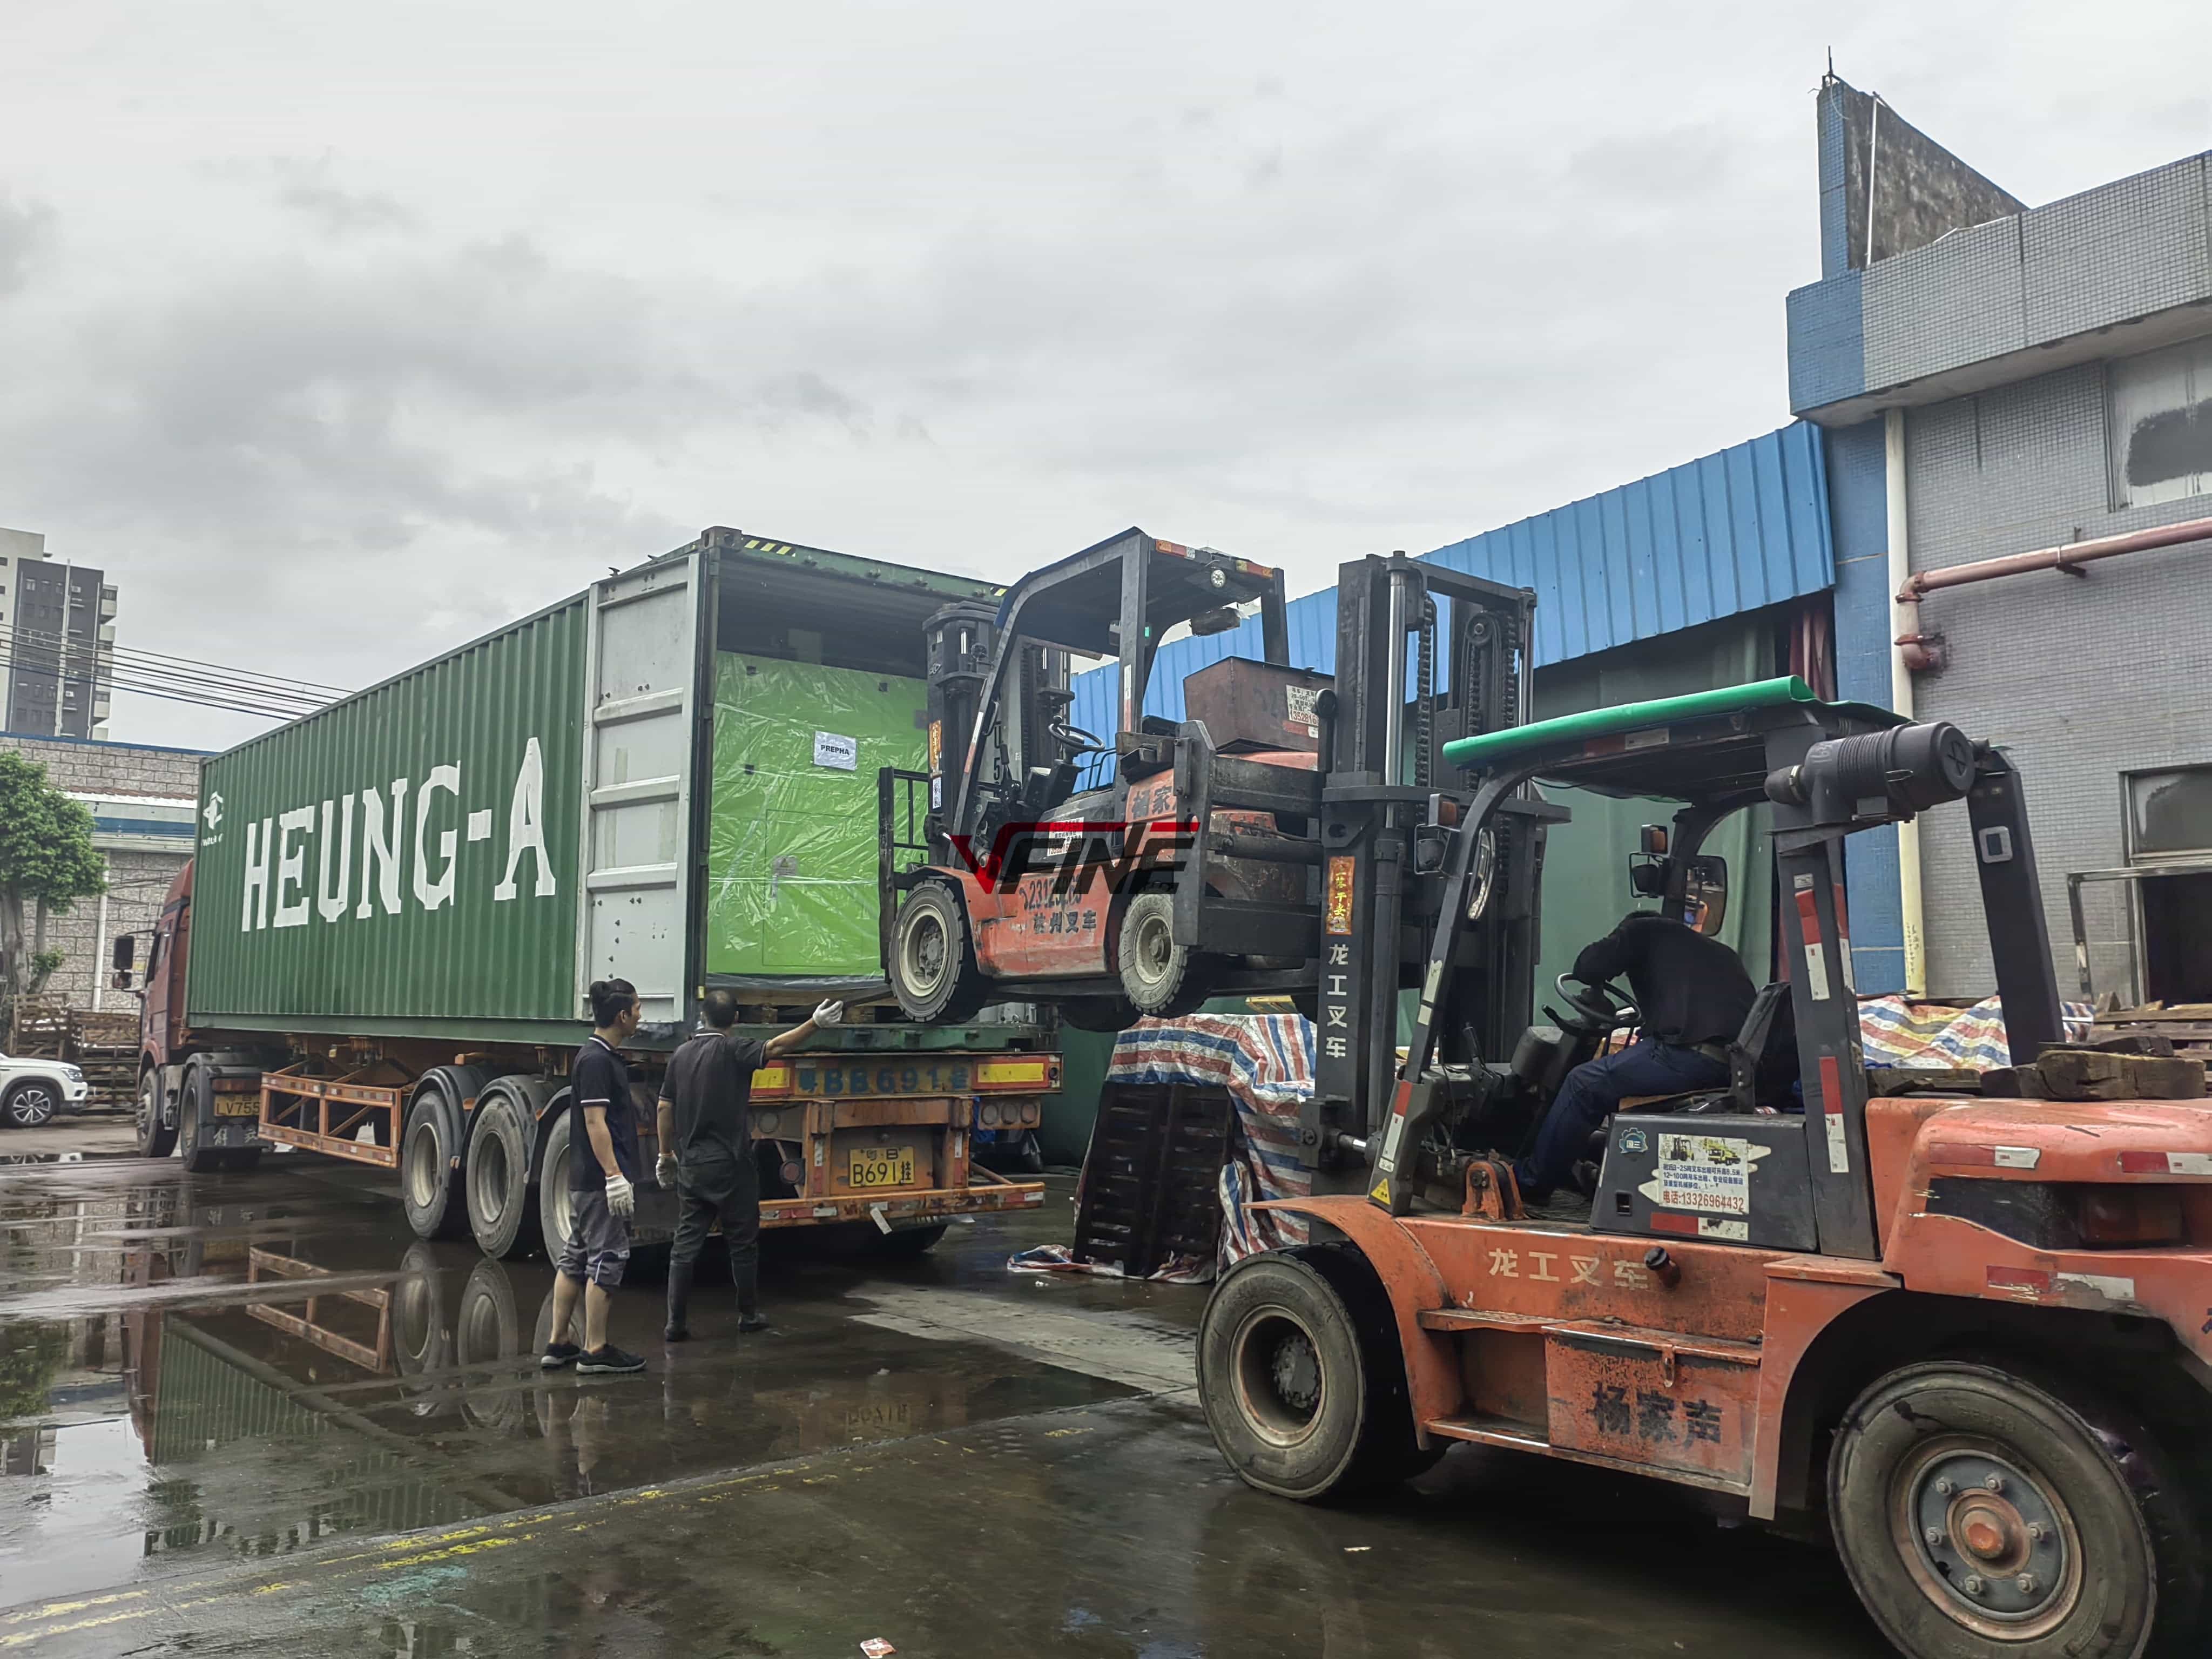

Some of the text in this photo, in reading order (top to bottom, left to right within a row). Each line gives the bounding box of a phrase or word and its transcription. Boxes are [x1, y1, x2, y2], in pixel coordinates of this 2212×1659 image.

[1290, 709, 1318, 725] 1352816
[820, 744, 850, 756] PREPHA
[1131, 785, 1176, 820] 杨家
[241, 737, 556, 932] HEUNG-A
[1326, 944, 1349, 1058] 龙工叉车
[853, 1161, 912, 1184] B691挂
[1488, 1247, 1648, 1291] 龙工叉车
[1585, 1382, 1722, 1450] 杨家声
